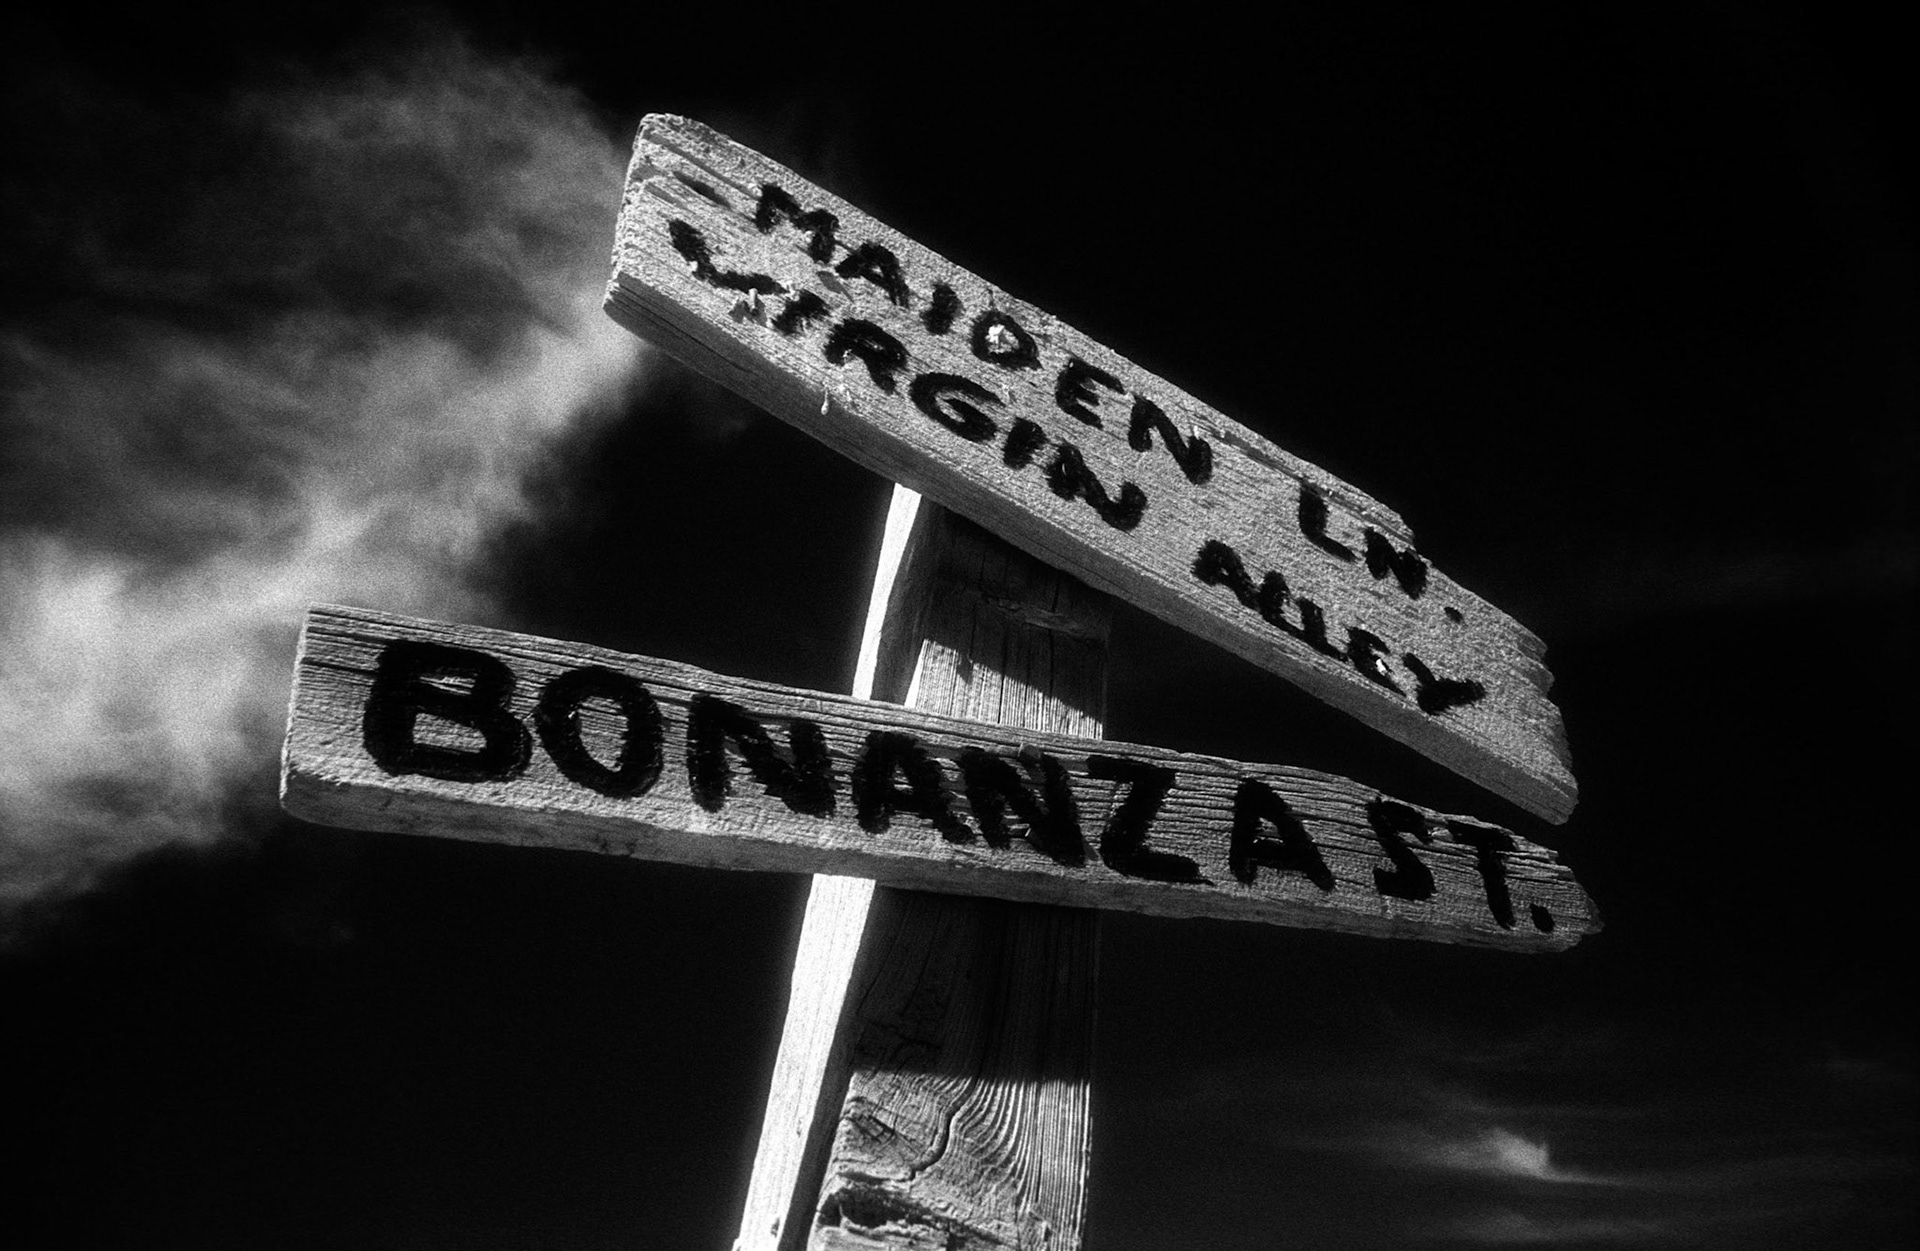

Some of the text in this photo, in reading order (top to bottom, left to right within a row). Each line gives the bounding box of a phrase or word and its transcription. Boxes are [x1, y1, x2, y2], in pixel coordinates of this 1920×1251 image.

[668, 220, 1487, 715] VIRGIN ALLEY
[756, 184, 1213, 485] MAIDEN
[362, 639, 1557, 933] BONANZA ST.
